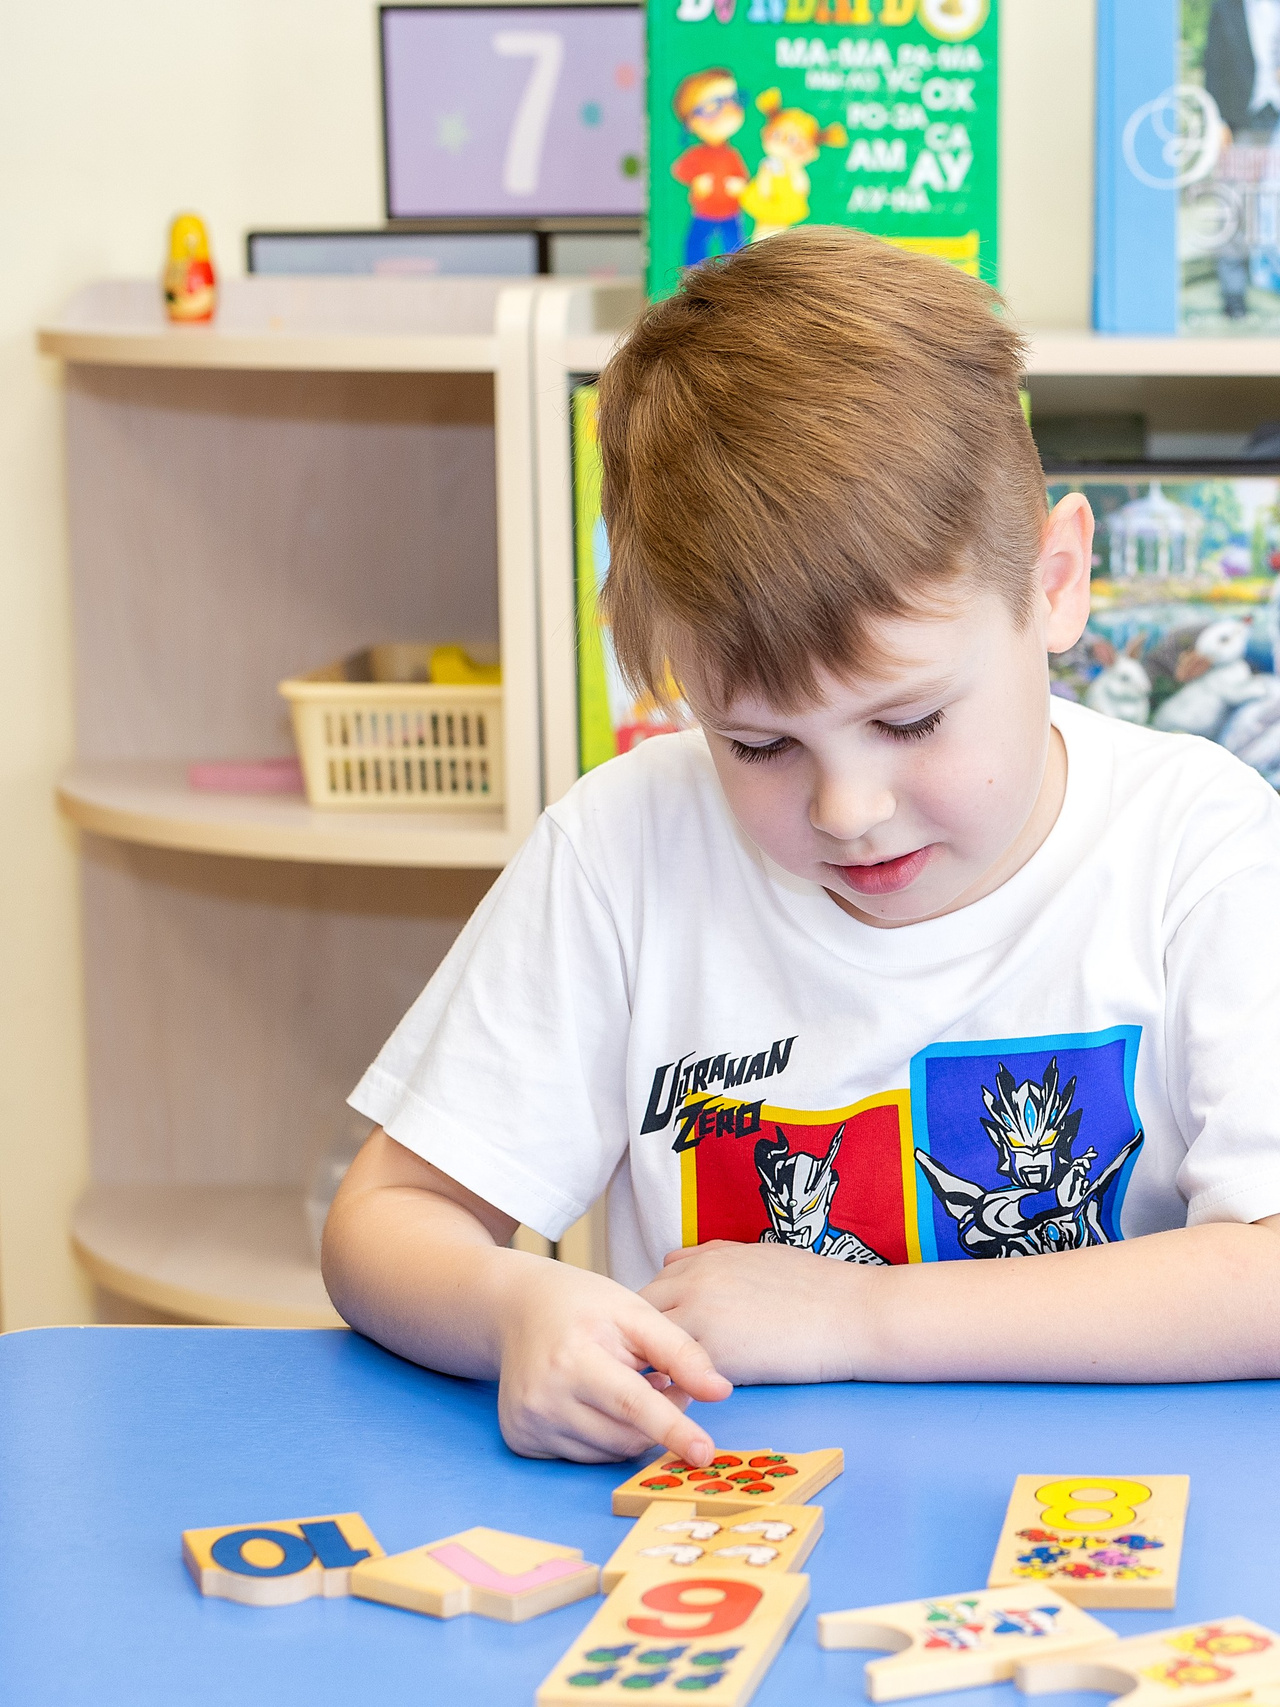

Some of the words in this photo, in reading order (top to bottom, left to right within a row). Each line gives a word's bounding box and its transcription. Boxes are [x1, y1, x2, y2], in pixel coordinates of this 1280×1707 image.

[494, 30, 564, 194] 7
[640, 1035, 799, 1135] ULTRAMAN
[671, 1093, 766, 1154] ZERO
[1034, 1477, 1153, 1531] 8
